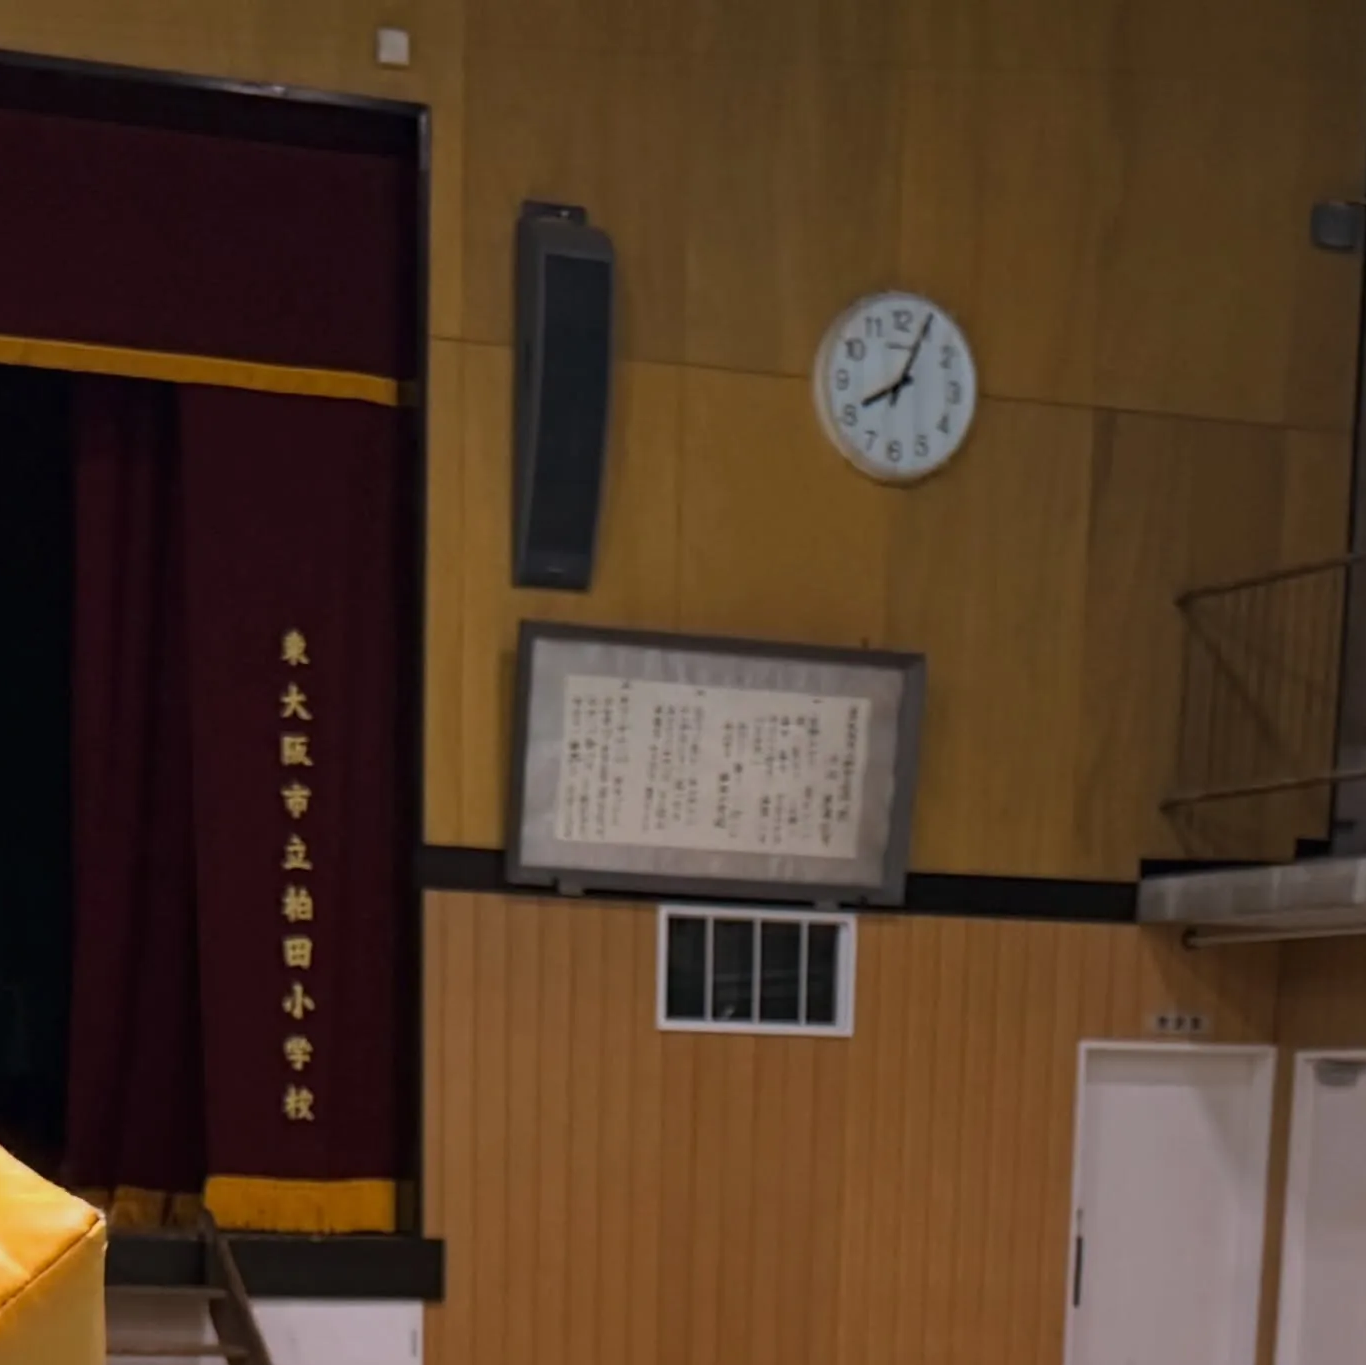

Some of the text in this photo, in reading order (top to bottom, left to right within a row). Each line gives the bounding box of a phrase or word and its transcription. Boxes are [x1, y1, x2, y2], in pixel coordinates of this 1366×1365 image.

[865, 315, 883, 338] 11
[892, 310, 913, 333] 12
[845, 337, 866, 362] 10
[865, 430, 878, 451] 7
[887, 440, 902, 463] 6
[915, 434, 929, 457] 5
